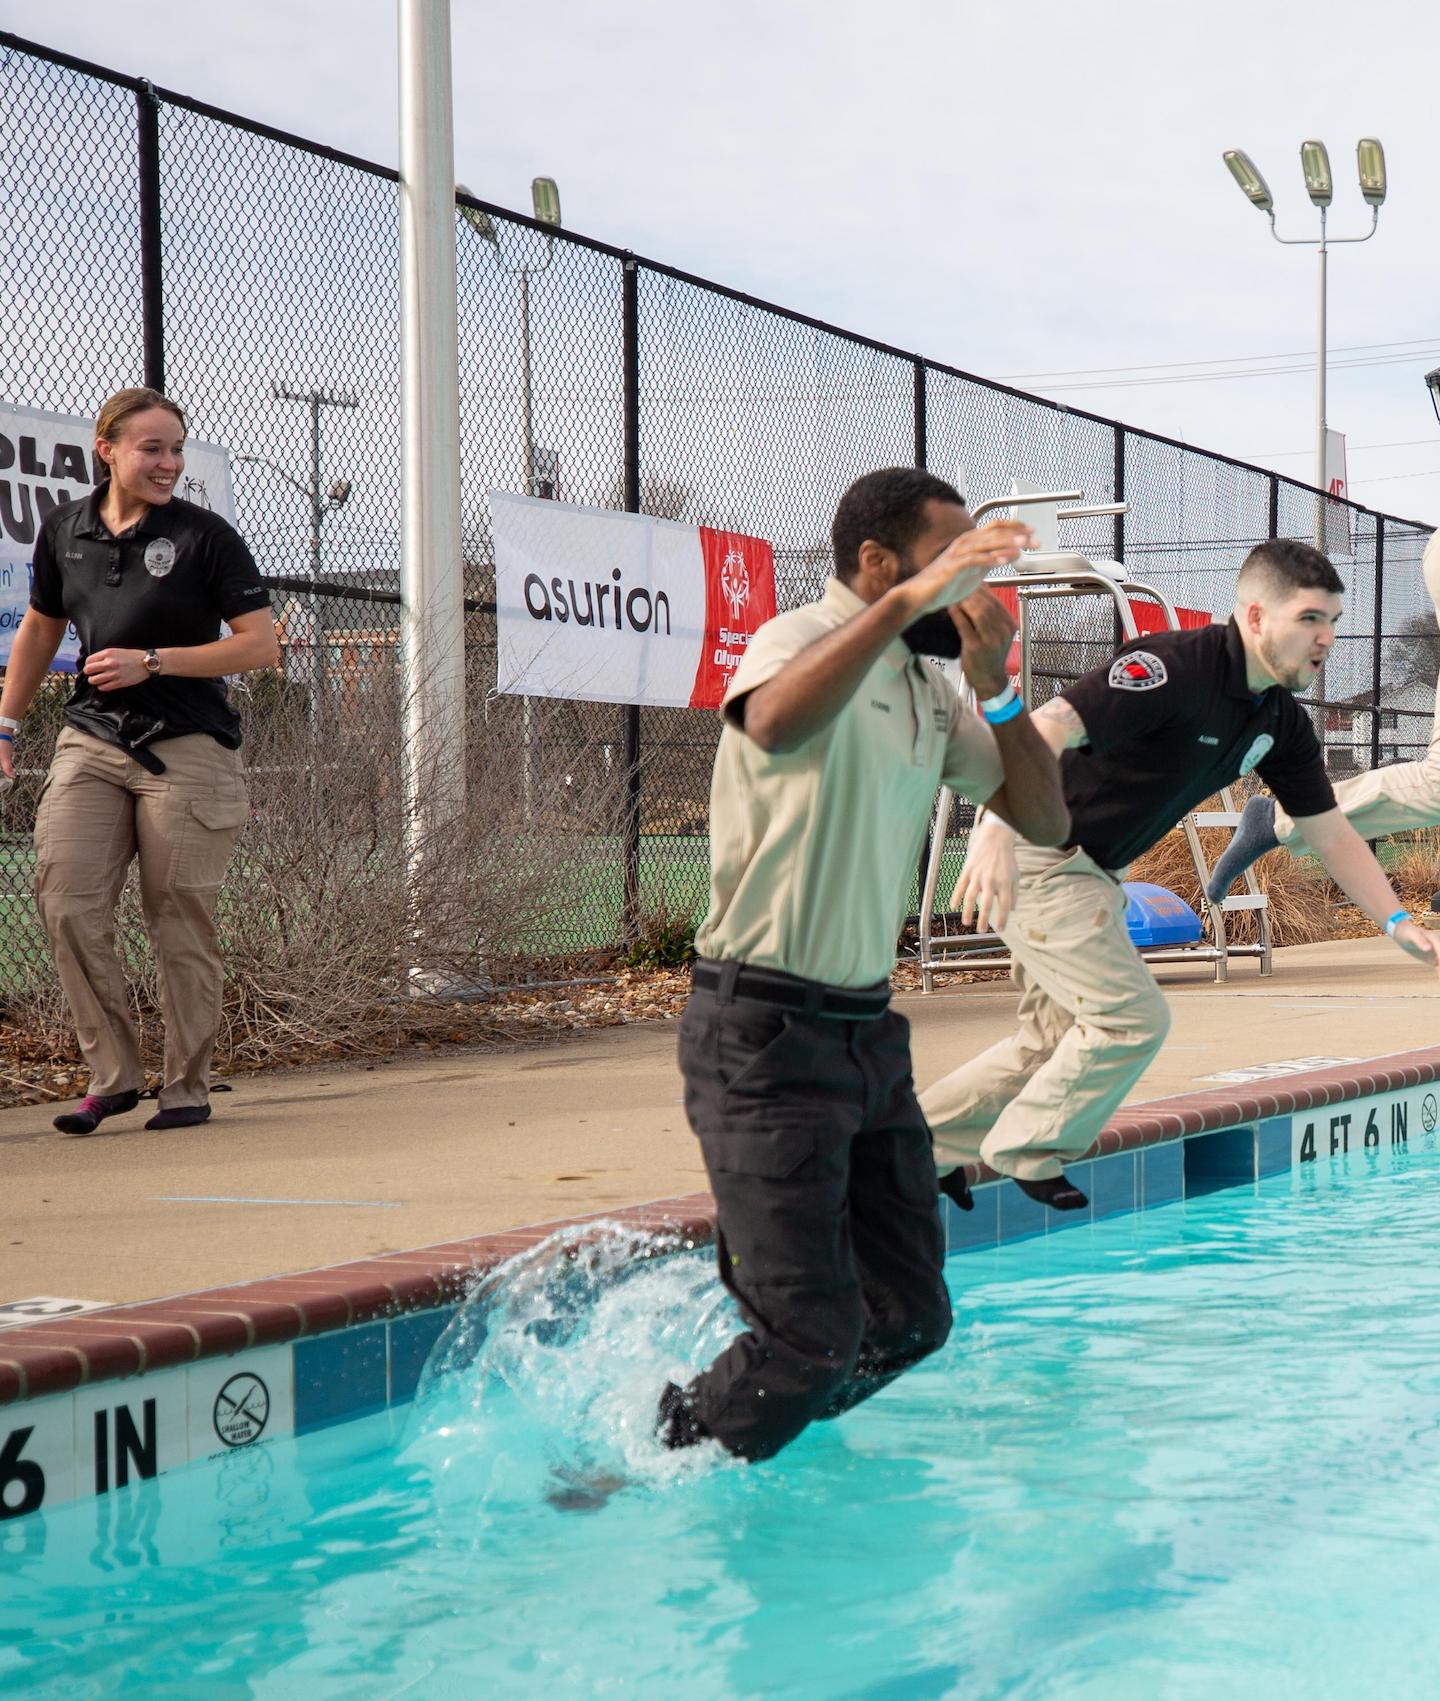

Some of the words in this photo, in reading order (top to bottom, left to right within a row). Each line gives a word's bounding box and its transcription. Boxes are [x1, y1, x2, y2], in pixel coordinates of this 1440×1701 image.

[524, 567, 671, 635] asurion
[1300, 1122, 1317, 1163] 4
[1330, 1114, 1352, 1157] FT
[1364, 1107, 1380, 1148] 6
[1391, 1101, 1408, 1145] IN
[0, 1425, 46, 1521] 6
[94, 1397, 158, 1497] IN
